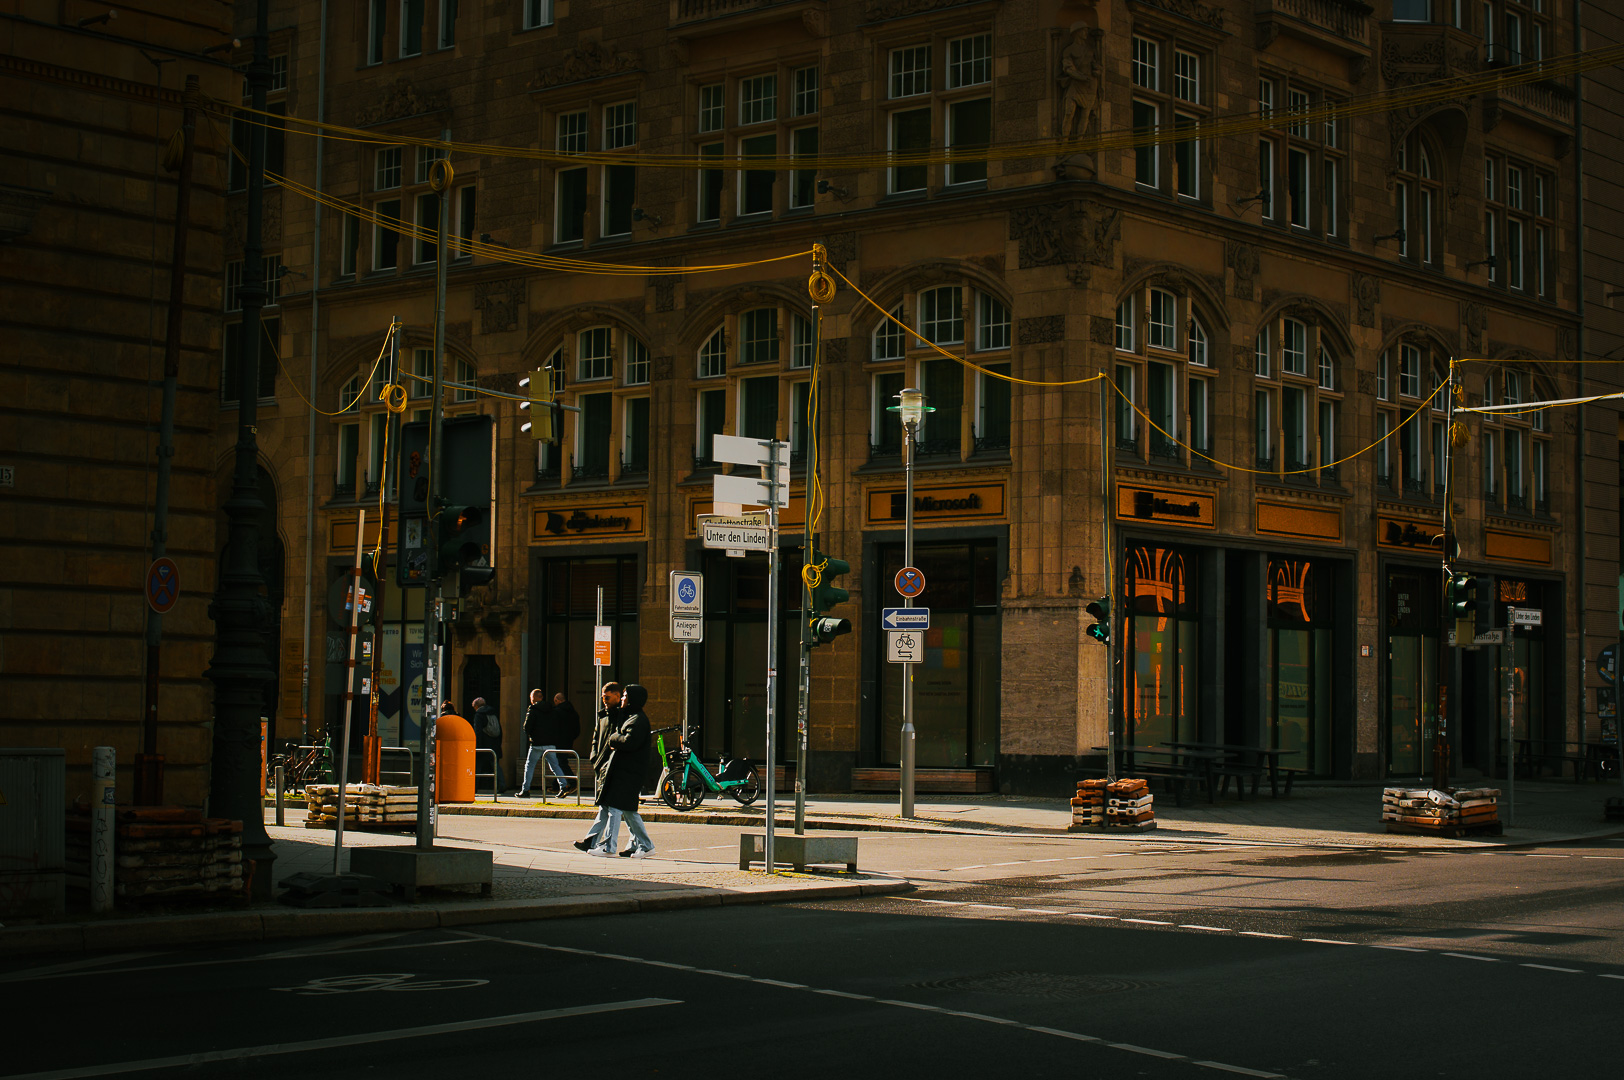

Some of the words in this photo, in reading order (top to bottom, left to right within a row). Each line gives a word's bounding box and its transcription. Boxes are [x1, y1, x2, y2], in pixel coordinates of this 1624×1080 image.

[914, 493, 981, 512] Microsoft
[1154, 498, 1200, 518] Microsoft
[706, 530, 726, 542] Unter
[728, 531, 741, 543] den
[744, 532, 767, 545] Linden
[1515, 611, 1524, 620] Unter
[1531, 613, 1540, 621] Linden
[676, 621, 698, 631] Anlieger
